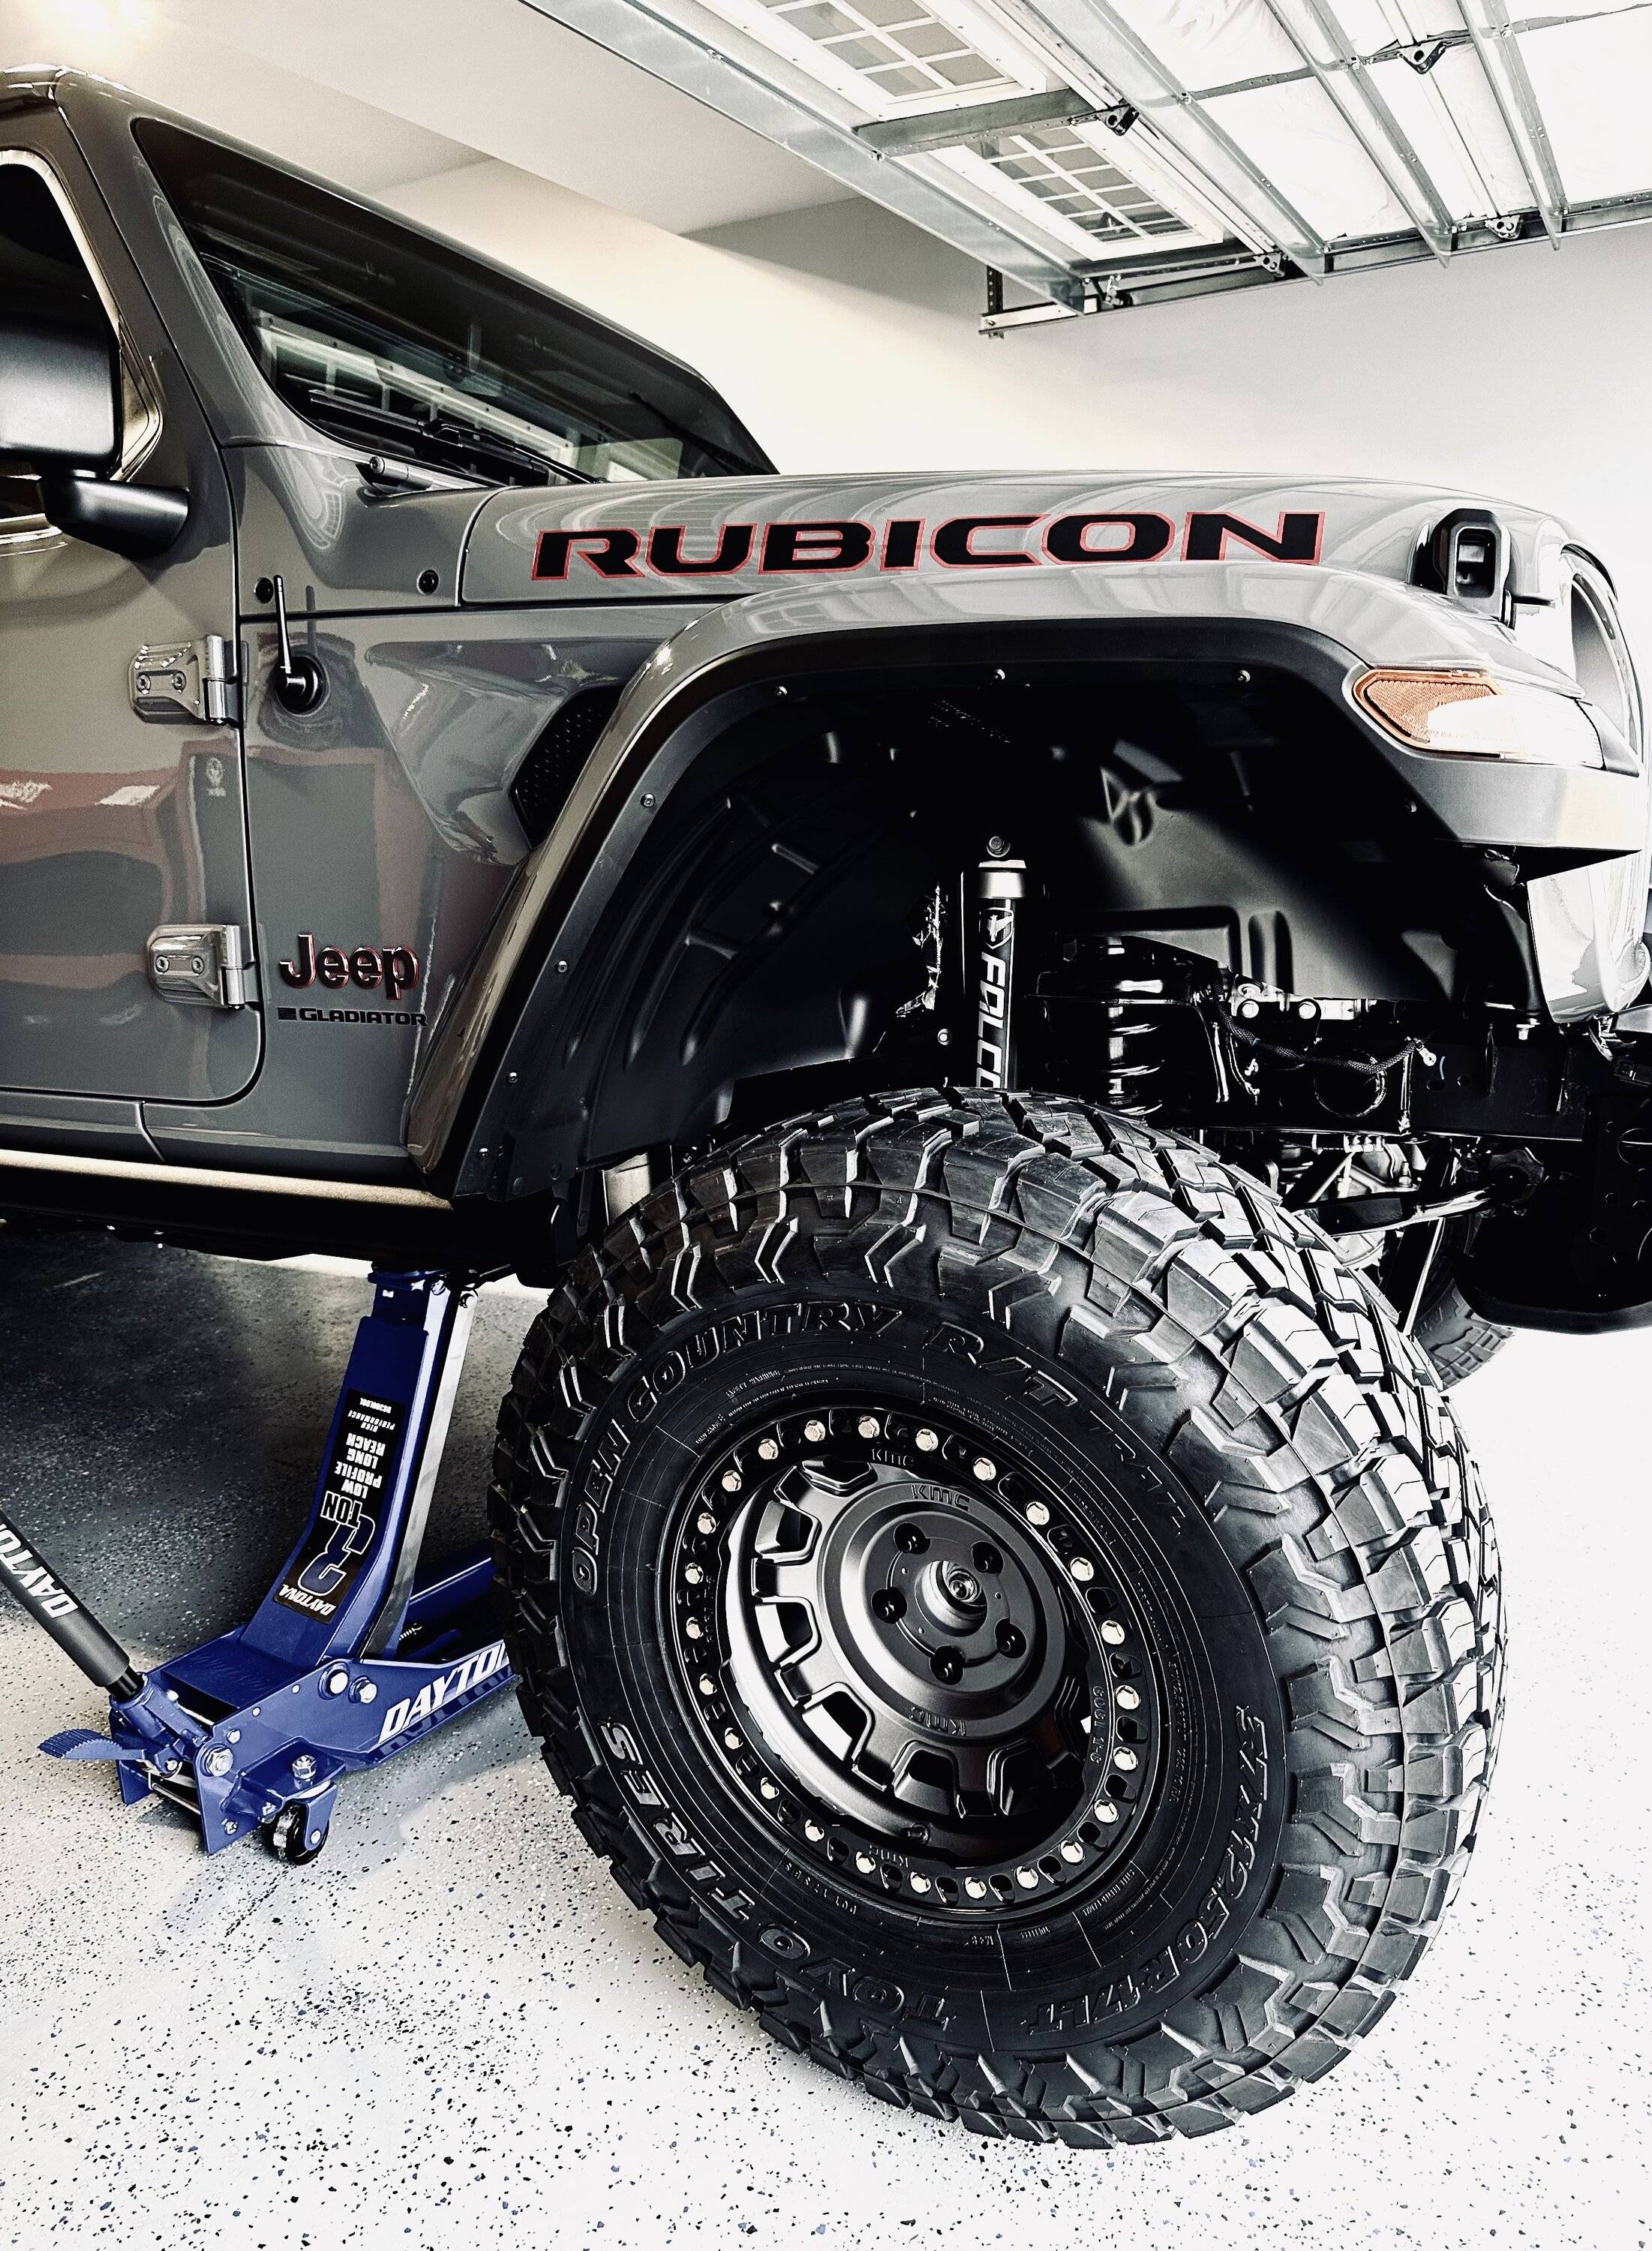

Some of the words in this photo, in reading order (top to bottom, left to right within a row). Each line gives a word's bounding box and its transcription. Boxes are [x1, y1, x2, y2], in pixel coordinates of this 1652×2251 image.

[530, 511, 1326, 582] RUBICON
[278, 931, 420, 1000] Jeep
[299, 1007, 428, 1027] GLADIATOR
[347, 1410, 395, 1430] PERFORMANCE
[346, 1432, 386, 1456] REACH
[346, 1447, 379, 1469] LONG
[572, 1418, 631, 1596] OPEN
[627, 1300, 903, 1422] COUNTRY
[335, 1461, 383, 1489] PROFILE
[341, 1479, 369, 1499] LOW
[320, 1490, 363, 1530] TON
[0, 1524, 79, 1618] DAYTO
[297, 1513, 376, 1597] 3
[278, 1584, 337, 1616] DAYTONA
[601, 1721, 756, 1921] TIRES
[758, 1923, 948, 2031] TOYO
